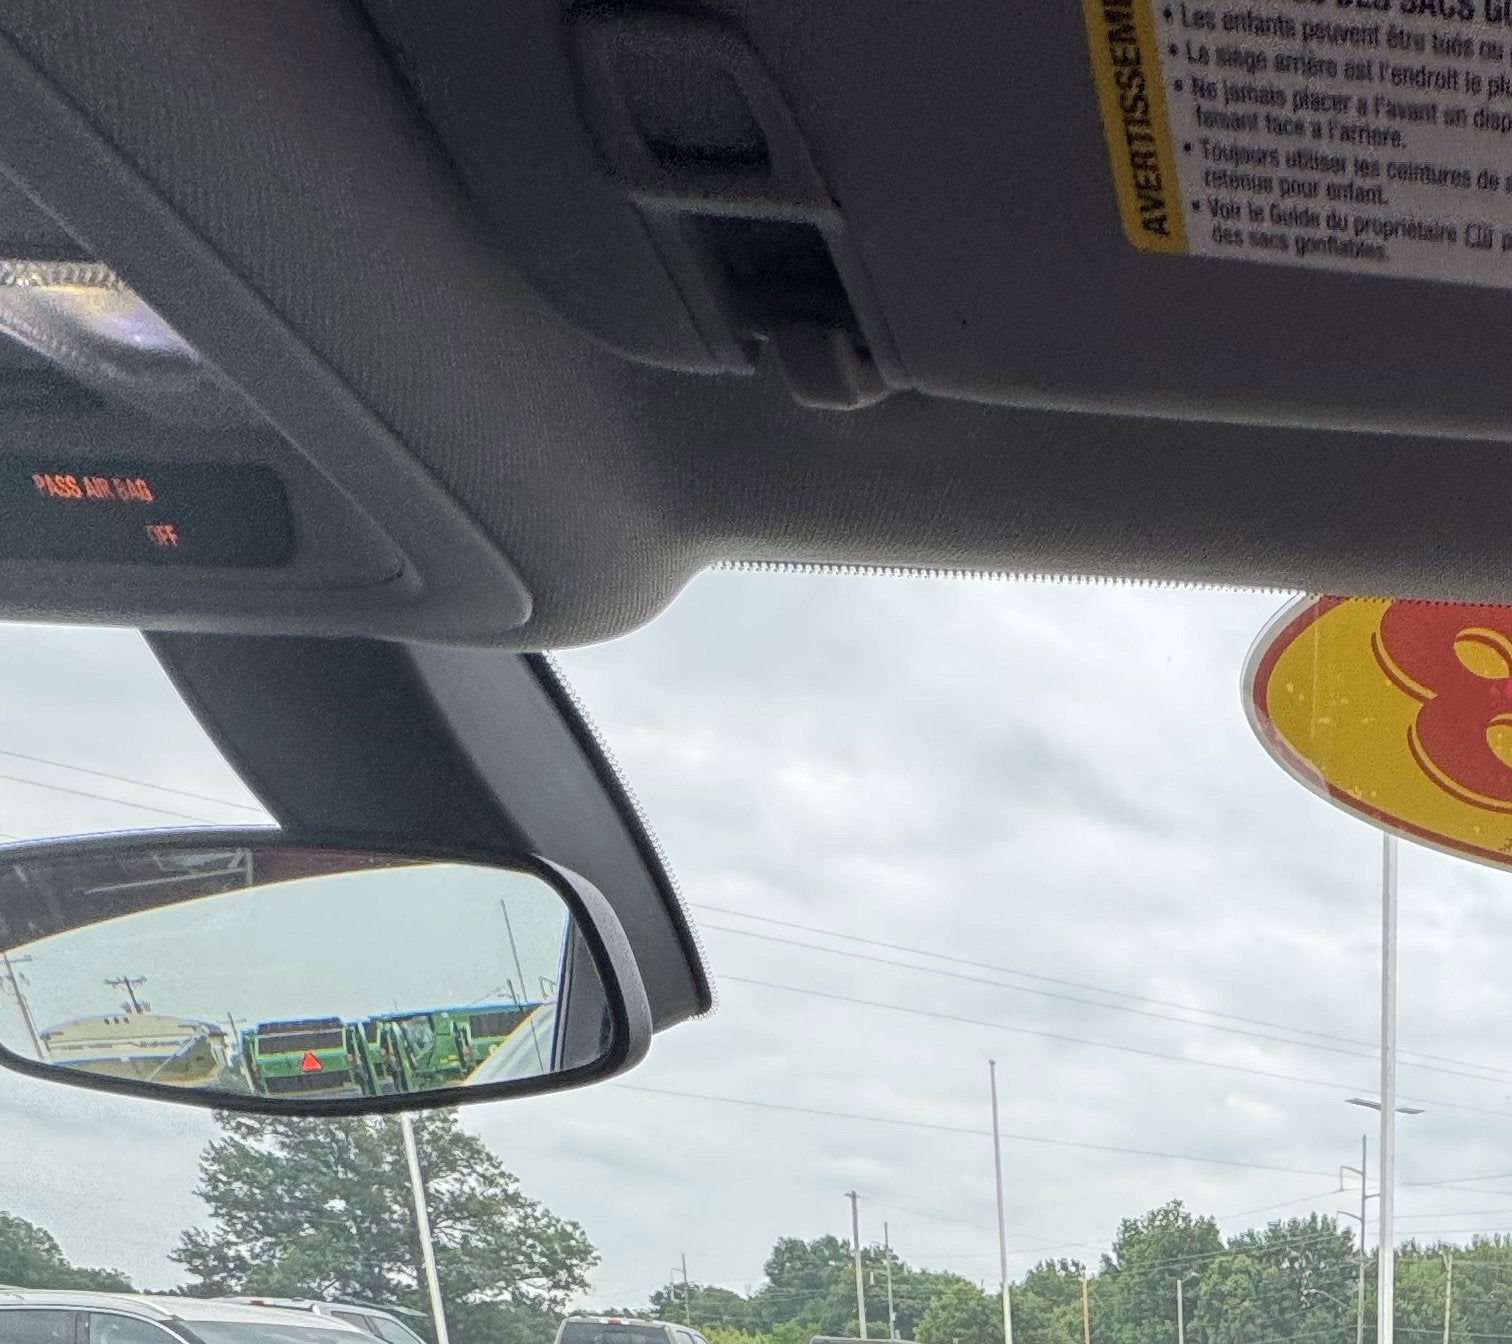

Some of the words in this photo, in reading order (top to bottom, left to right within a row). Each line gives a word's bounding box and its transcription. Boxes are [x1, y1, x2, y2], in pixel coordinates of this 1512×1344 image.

[1181, 2, 1216, 31] Les
[1222, 9, 1296, 38] enfants
[1302, 20, 1379, 46] peuvent
[1378, 60, 1459, 91] l'endroit
[1464, 68, 1483, 95] le
[1224, 79, 1288, 107] jamais
[1292, 87, 1353, 114] placer
[1102, 0, 1168, 237] AVERTISSEM
[1201, 137, 1280, 169] Toujours
[1285, 146, 1347, 174] utiliser
[1354, 156, 1381, 178] les
[1386, 160, 1472, 190] ceintures
[1477, 168, 1500, 191] de
[1204, 168, 1274, 193] retenue
[1278, 175, 1321, 198] pour
[1208, 196, 1241, 220] Voir
[1248, 200, 1266, 222] le
[1269, 202, 1322, 228] Guide
[1326, 209, 1348, 230] du
[1354, 213, 1457, 244] propriétaire
[1211, 222, 1245, 248] des
[32, 473, 83, 499] PASS
[84, 475, 114, 500] AIR
[114, 477, 155, 502] BAG
